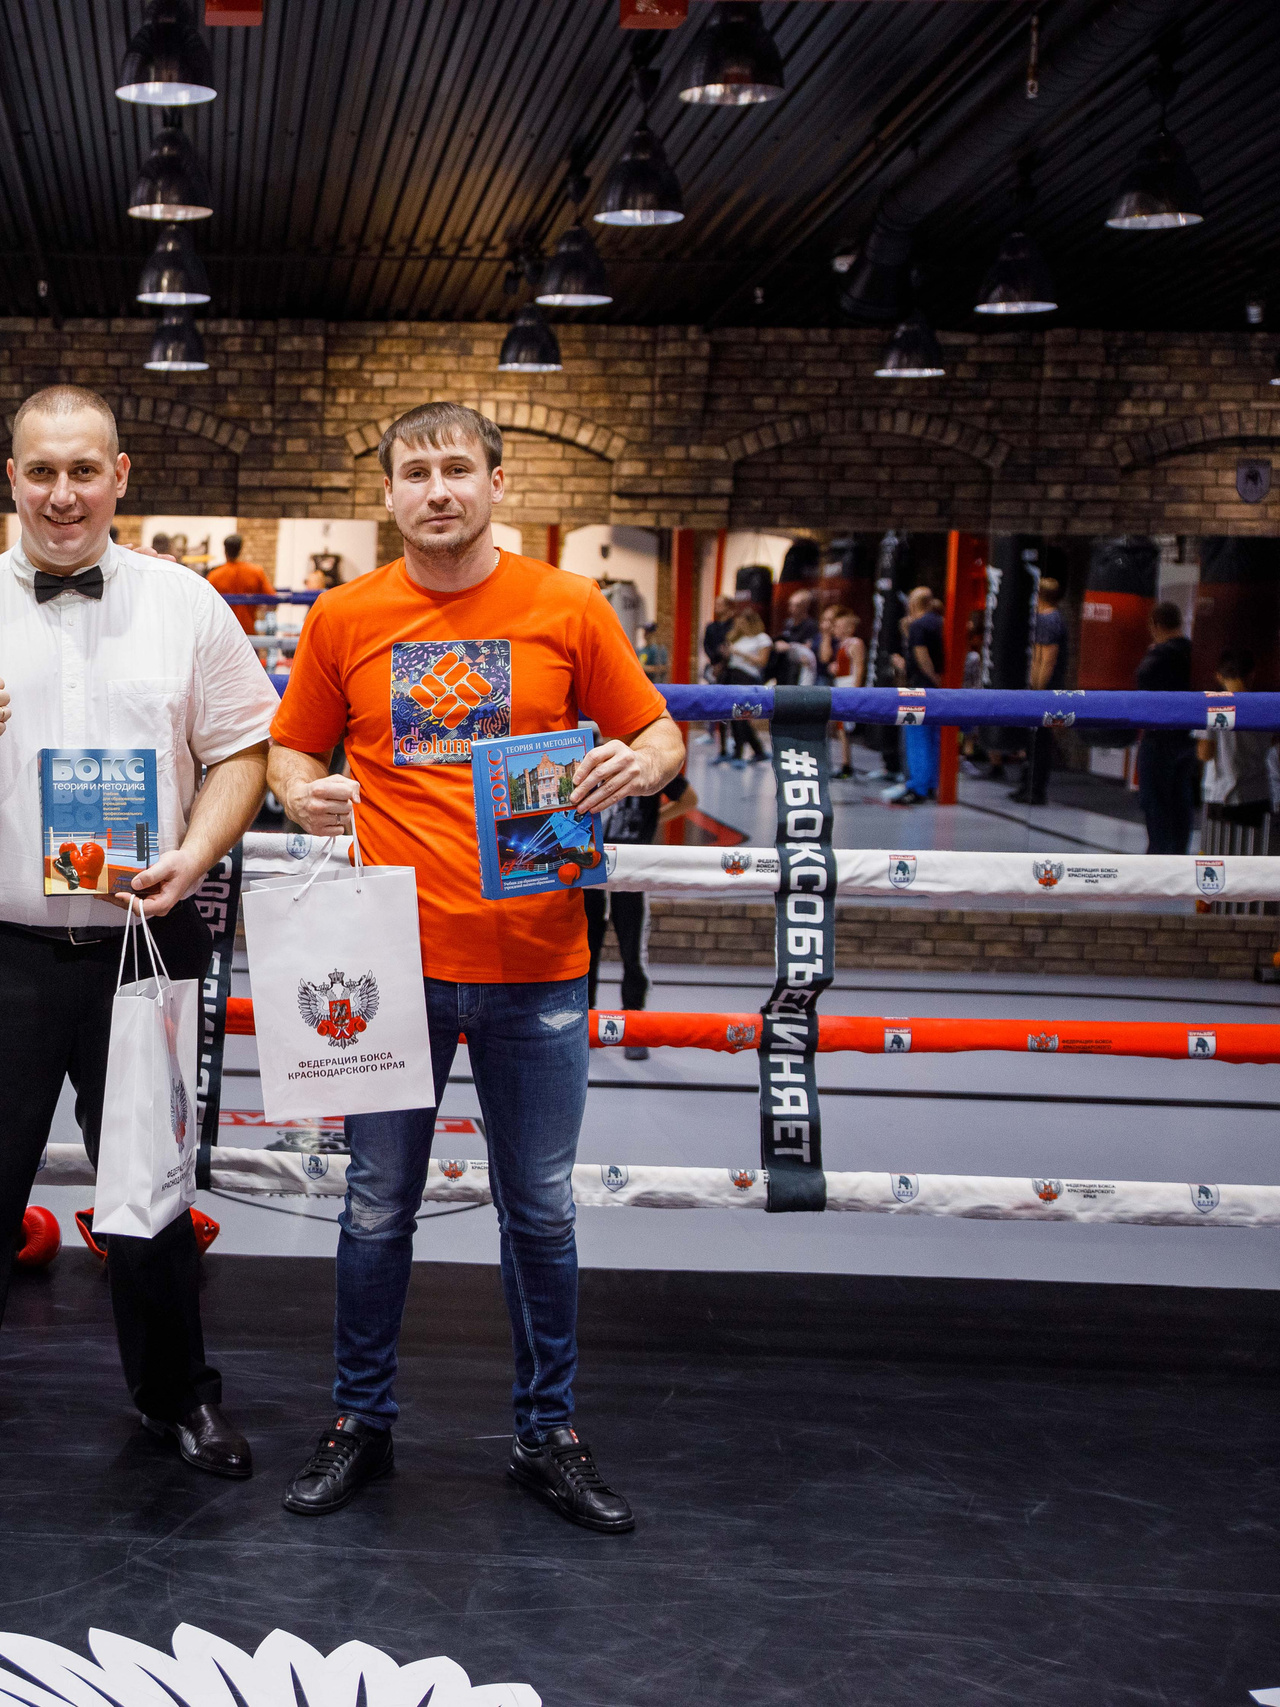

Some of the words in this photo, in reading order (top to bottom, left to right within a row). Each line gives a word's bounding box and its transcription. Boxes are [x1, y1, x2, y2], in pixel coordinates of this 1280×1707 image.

[399, 732, 494, 756] Colum
[505, 743, 534, 754] ТЕОРИЯ
[543, 736, 583, 749] МЕТОДИКА
[52, 757, 145, 781] БОКС
[53, 782, 89, 792] теория
[98, 782, 145, 792] методика
[487, 748, 510, 819] БОКС
[769, 748, 827, 1164] #БОКСОБЪЕДИНЯЕТ
[288, 1064, 378, 1080] КРАСНОДАРСКОГО
[380, 1061, 405, 1071] КРАЯ
[298, 1056, 358, 1069] ФЕДЕРАЦИЯ
[360, 1051, 393, 1063] БОКСА
